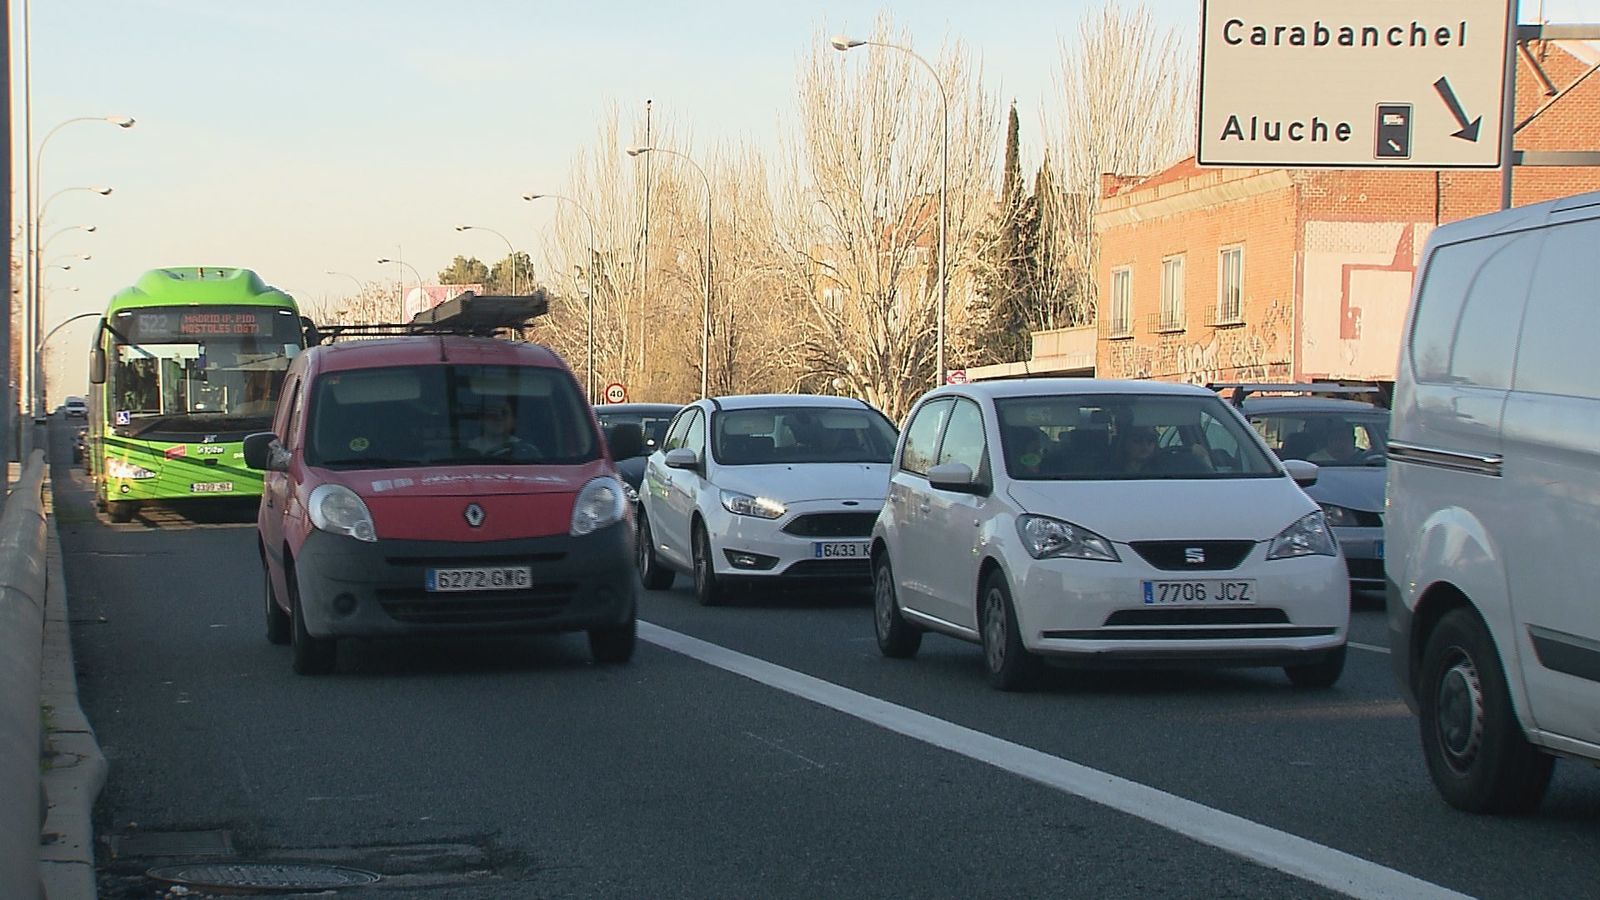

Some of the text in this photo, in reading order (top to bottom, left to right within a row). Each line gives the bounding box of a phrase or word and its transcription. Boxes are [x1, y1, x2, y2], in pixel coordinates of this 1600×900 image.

[1223, 19, 1467, 47] Carabanchel
[1220, 114, 1352, 142] Aluche
[139, 314, 168, 332] 522
[184, 314, 220, 323] MADRID
[823, 543, 856, 557] 6433
[438, 570, 486, 588] 6272
[1158, 582, 1250, 602] 7706 JCZ
